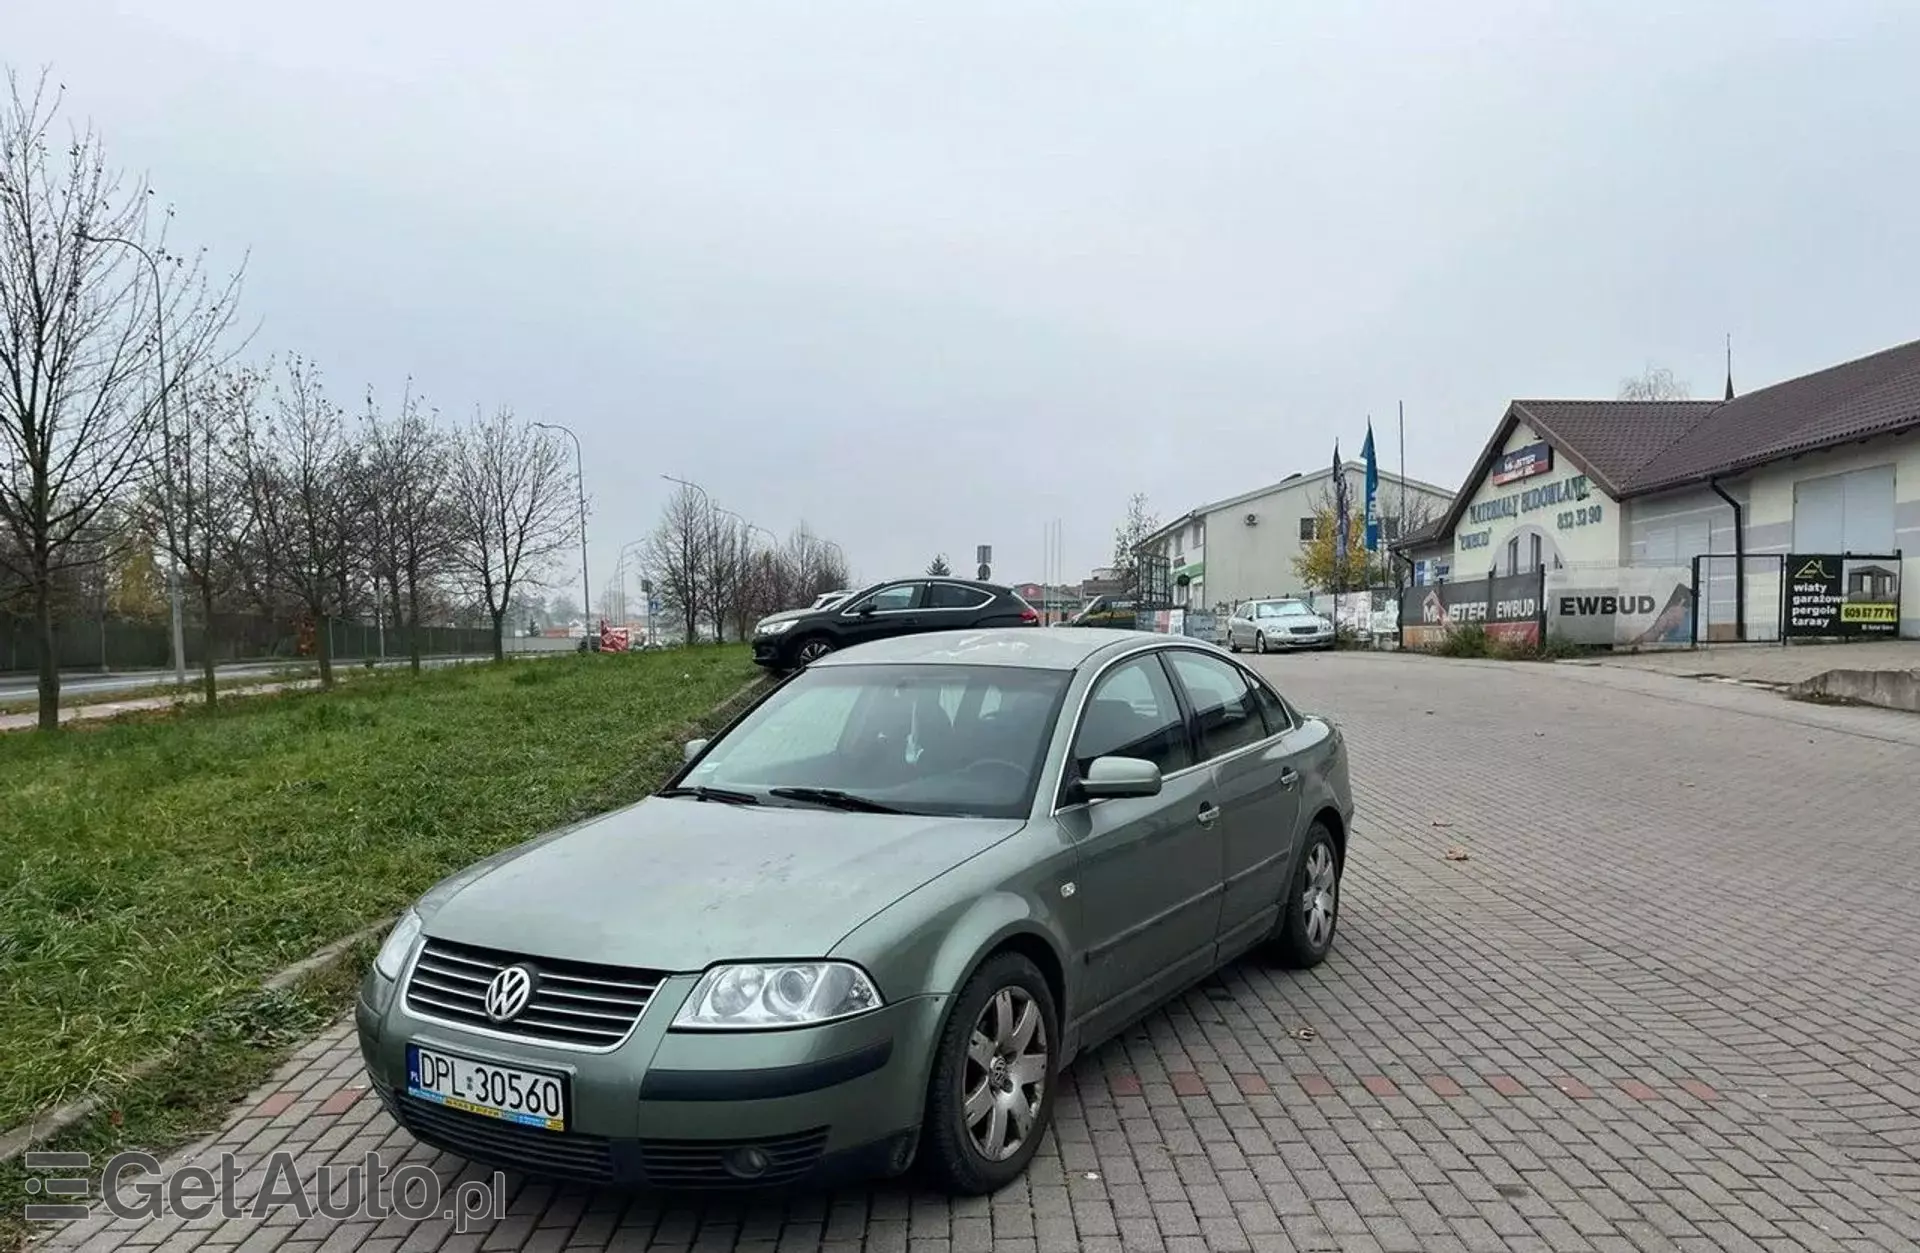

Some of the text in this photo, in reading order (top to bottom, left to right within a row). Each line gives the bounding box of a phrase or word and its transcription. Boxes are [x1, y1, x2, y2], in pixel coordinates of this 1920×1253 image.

[1793, 582, 1828, 593] wiaty
[1560, 594, 1656, 616] EWBUD
[1792, 594, 1848, 605] garażowe
[1496, 599, 1535, 619] EWBUD
[1792, 605, 1837, 617] pergole
[1791, 617, 1830, 628] tarasy
[410, 1071, 419, 1082] PL
[421, 1053, 465, 1097] DPL
[474, 1067, 560, 1117] 30560
